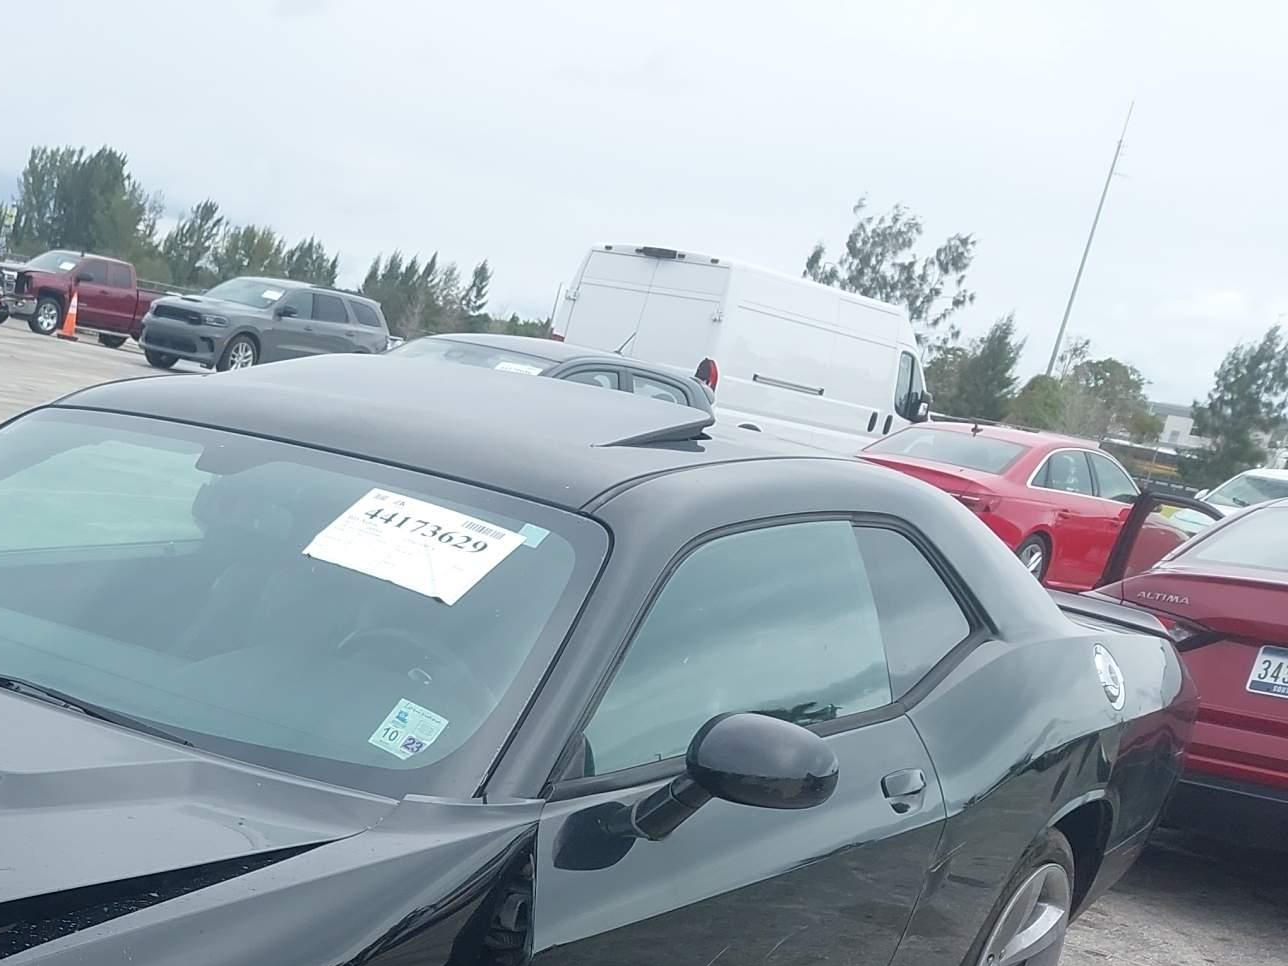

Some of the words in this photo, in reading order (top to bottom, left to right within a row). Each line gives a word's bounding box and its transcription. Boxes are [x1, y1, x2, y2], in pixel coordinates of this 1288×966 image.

[364, 507, 489, 553] 44173629
[1137, 591, 1190, 605] ALTIMA
[382, 727, 400, 742] 10
